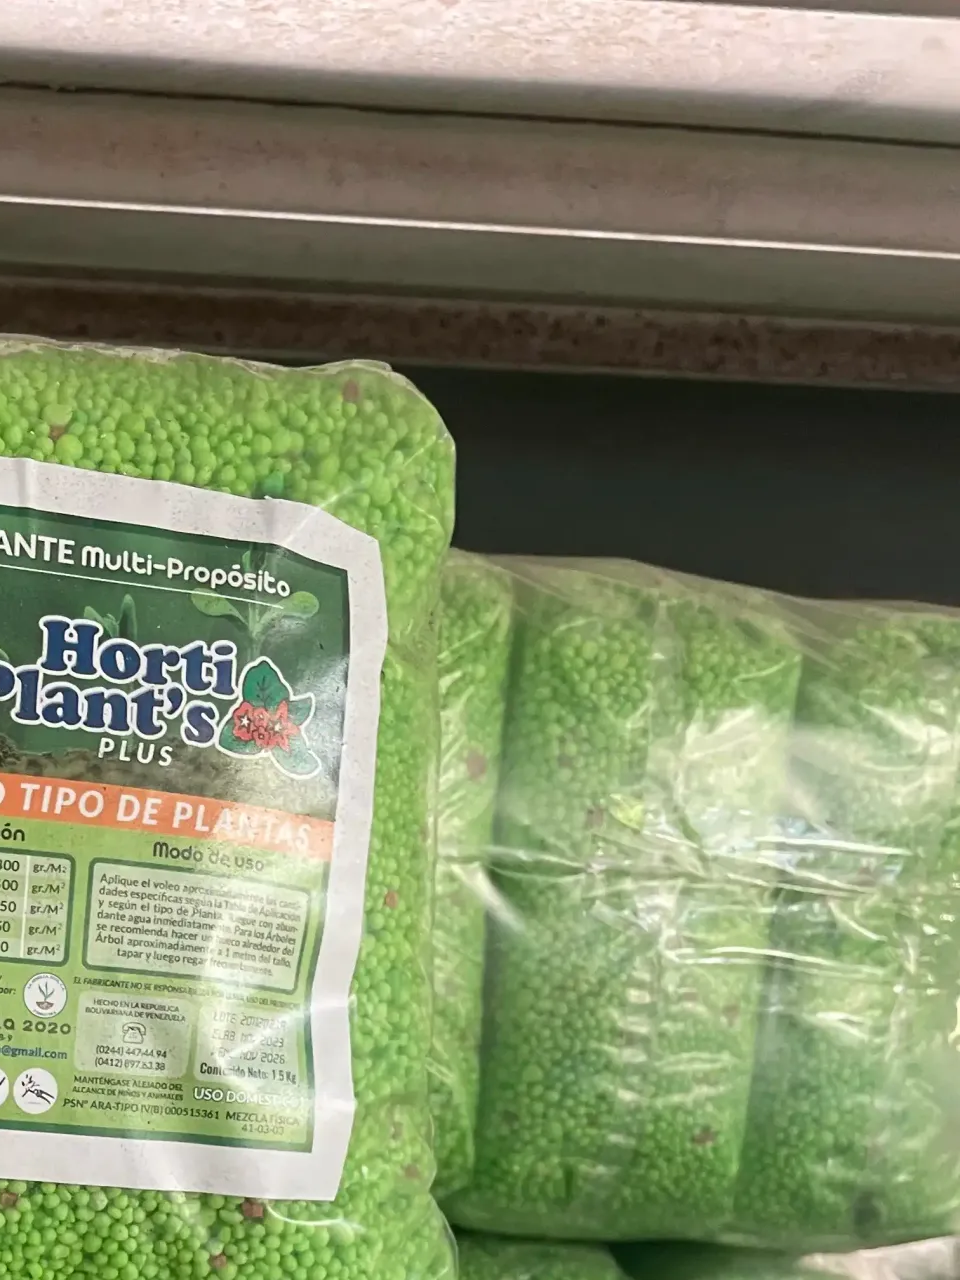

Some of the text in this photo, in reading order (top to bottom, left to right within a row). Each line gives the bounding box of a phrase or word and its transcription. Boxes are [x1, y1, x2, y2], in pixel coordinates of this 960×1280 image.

[81, 545, 291, 599] Multi-Propósito
[39, 615, 238, 698] Horti
[97, 740, 173, 768] PLUS
[20, 782, 104, 817] TIPO
[116, 794, 162, 826] DE
[172, 801, 311, 850] PLANTAS
[153, 841, 203, 862] Modo
[208, 847, 230, 866] de
[100, 873, 180, 892] Aplique el voleo
[98, 886, 128, 897] dades
[130, 890, 183, 904] específicas
[98, 899, 104, 909] y
[108, 900, 137, 911] según
[141, 903, 150, 912] el
[154, 904, 173, 915] tipo
[177, 906, 189, 916] de
[97, 910, 126, 921] dante
[128, 915, 151, 924] agua
[234, 925, 252, 937] Para
[253, 930, 265, 939] los
[95, 931, 124, 945] Árbol
[96, 923, 294, 956] se recomienda hacer alrededor del
[117, 948, 143, 959] tapar
[146, 953, 151, 962] y
[153, 951, 180, 963] luego
[83, 977, 129, 989] FABRICANTE
[130, 982, 142, 990] NO
[93, 999, 119, 1008] HECHO
[120, 1000, 130, 1008] EN
[85, 1006, 133, 1017] BOLIVARIANA
[145, 1012, 186, 1022] VENEZUELA
[22, 1020, 71, 1035] 2020
[96, 1045, 124, 1056] (0244)
[261, 1052, 285, 1064] 2026
[95, 1057, 123, 1068] (0412)
[132, 1079, 167, 1090] ALEJADO
[169, 1083, 183, 1091] DEL
[72, 1086, 183, 1101] ALCANCE DE NIÑOS ANIMALES
[194, 1086, 224, 1102] USO
[90, 1100, 267, 1123] ARA-TIPO IV(B) 000515361 MEZCLA
